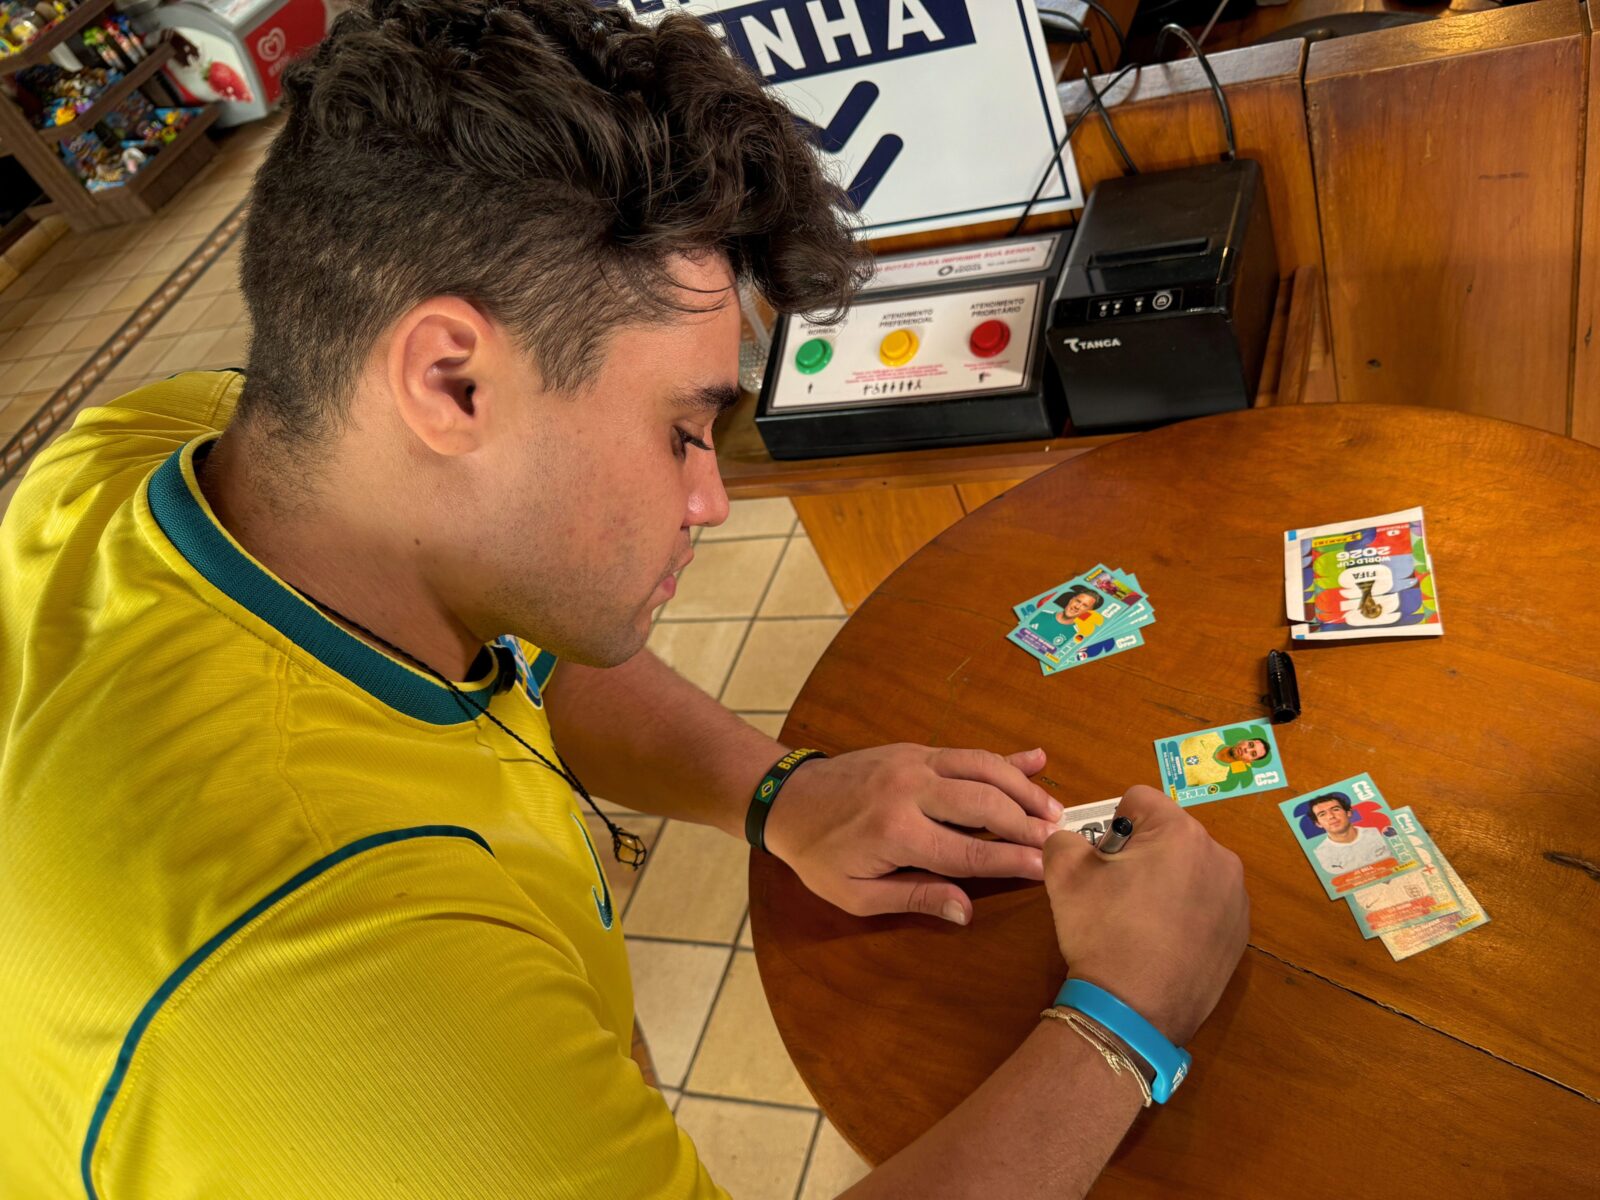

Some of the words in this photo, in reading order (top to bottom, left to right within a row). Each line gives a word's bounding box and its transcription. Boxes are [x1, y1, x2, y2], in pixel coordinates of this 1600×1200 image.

[1079, 337, 1121, 351] TANGA
[1336, 546, 1392, 562] 2026
[1356, 556, 1392, 565] WORLD
[1352, 570, 1377, 580] FIFA
